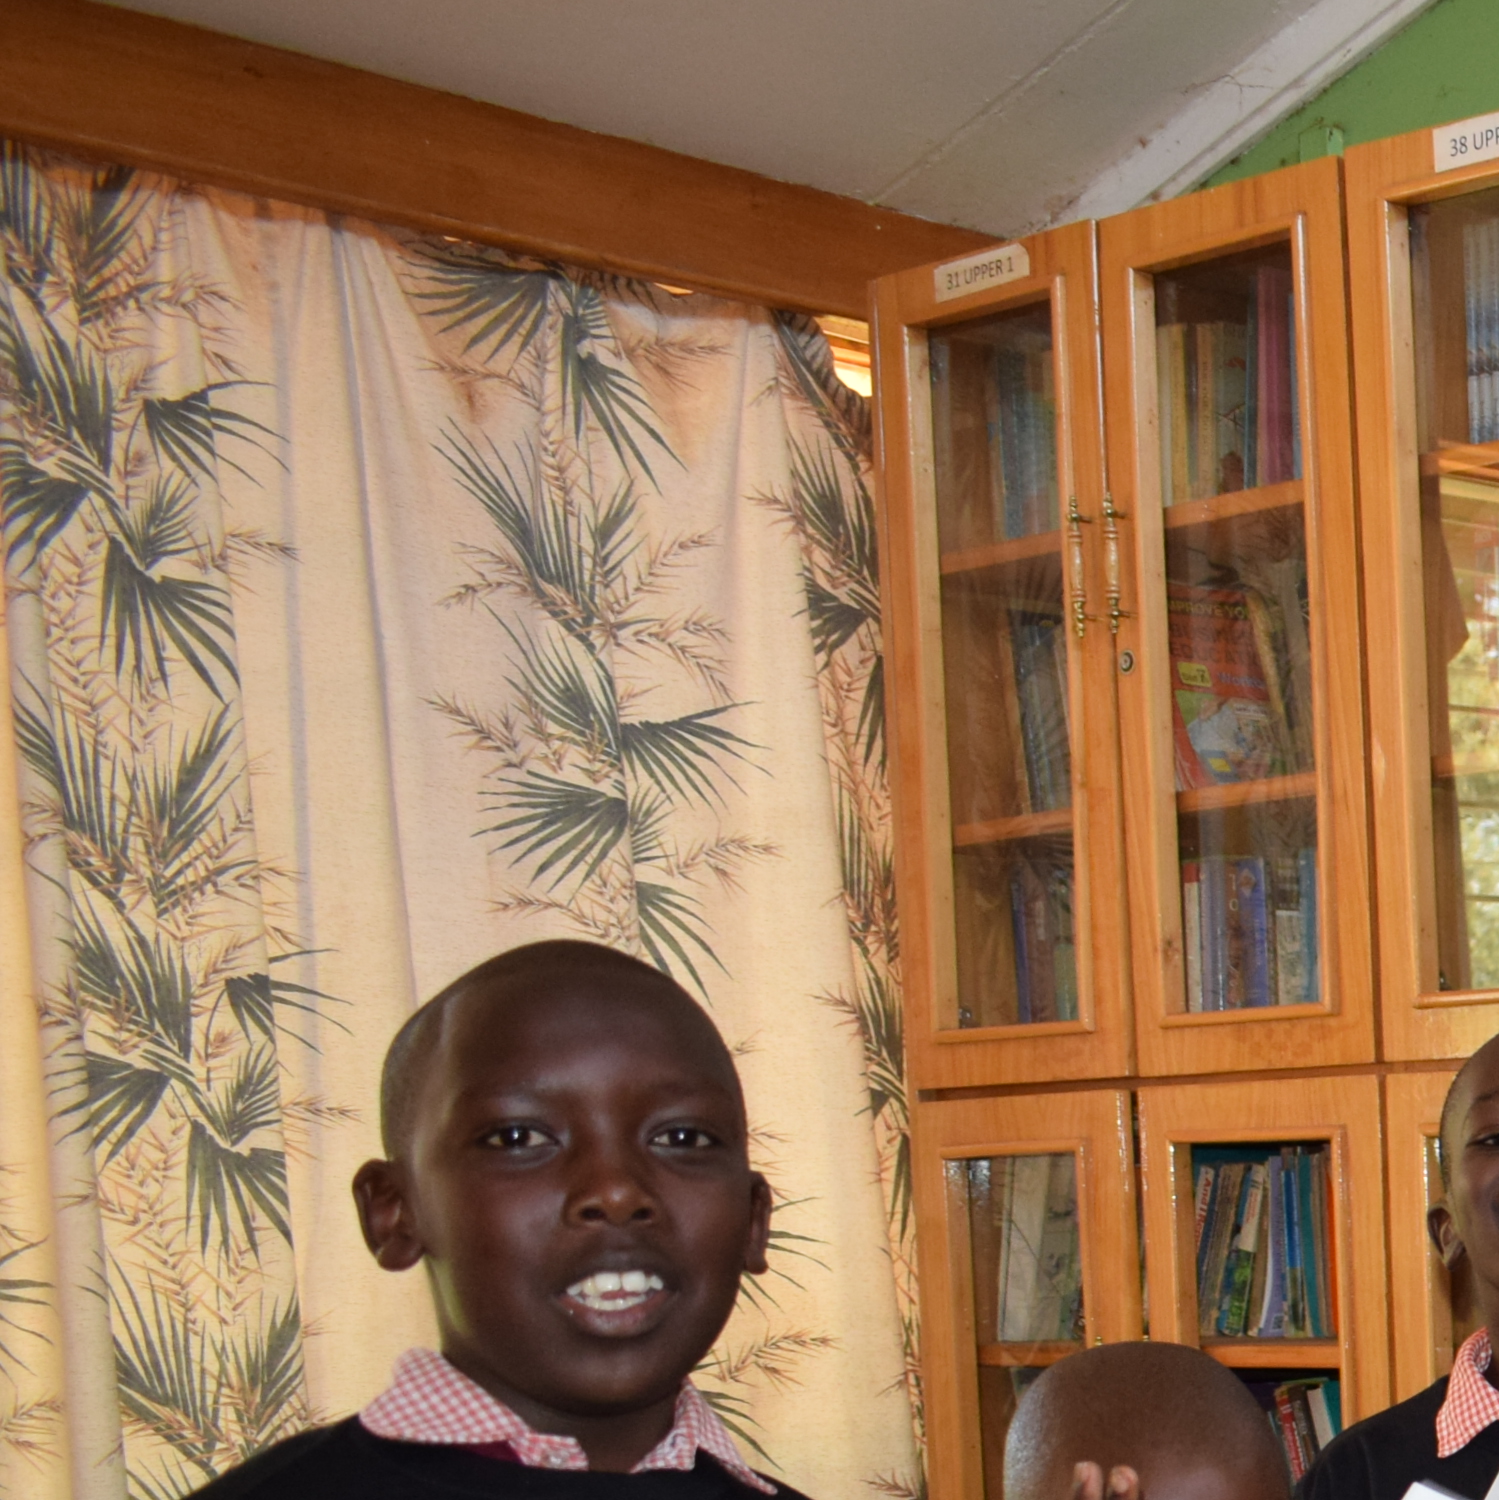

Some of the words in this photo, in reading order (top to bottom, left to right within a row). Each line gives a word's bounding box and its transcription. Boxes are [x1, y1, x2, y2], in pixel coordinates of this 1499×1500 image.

[1450, 136, 1468, 157] 38
[946, 271, 959, 290] 31
[964, 259, 1003, 284] UPPER
[1007, 257, 1014, 272] 1
